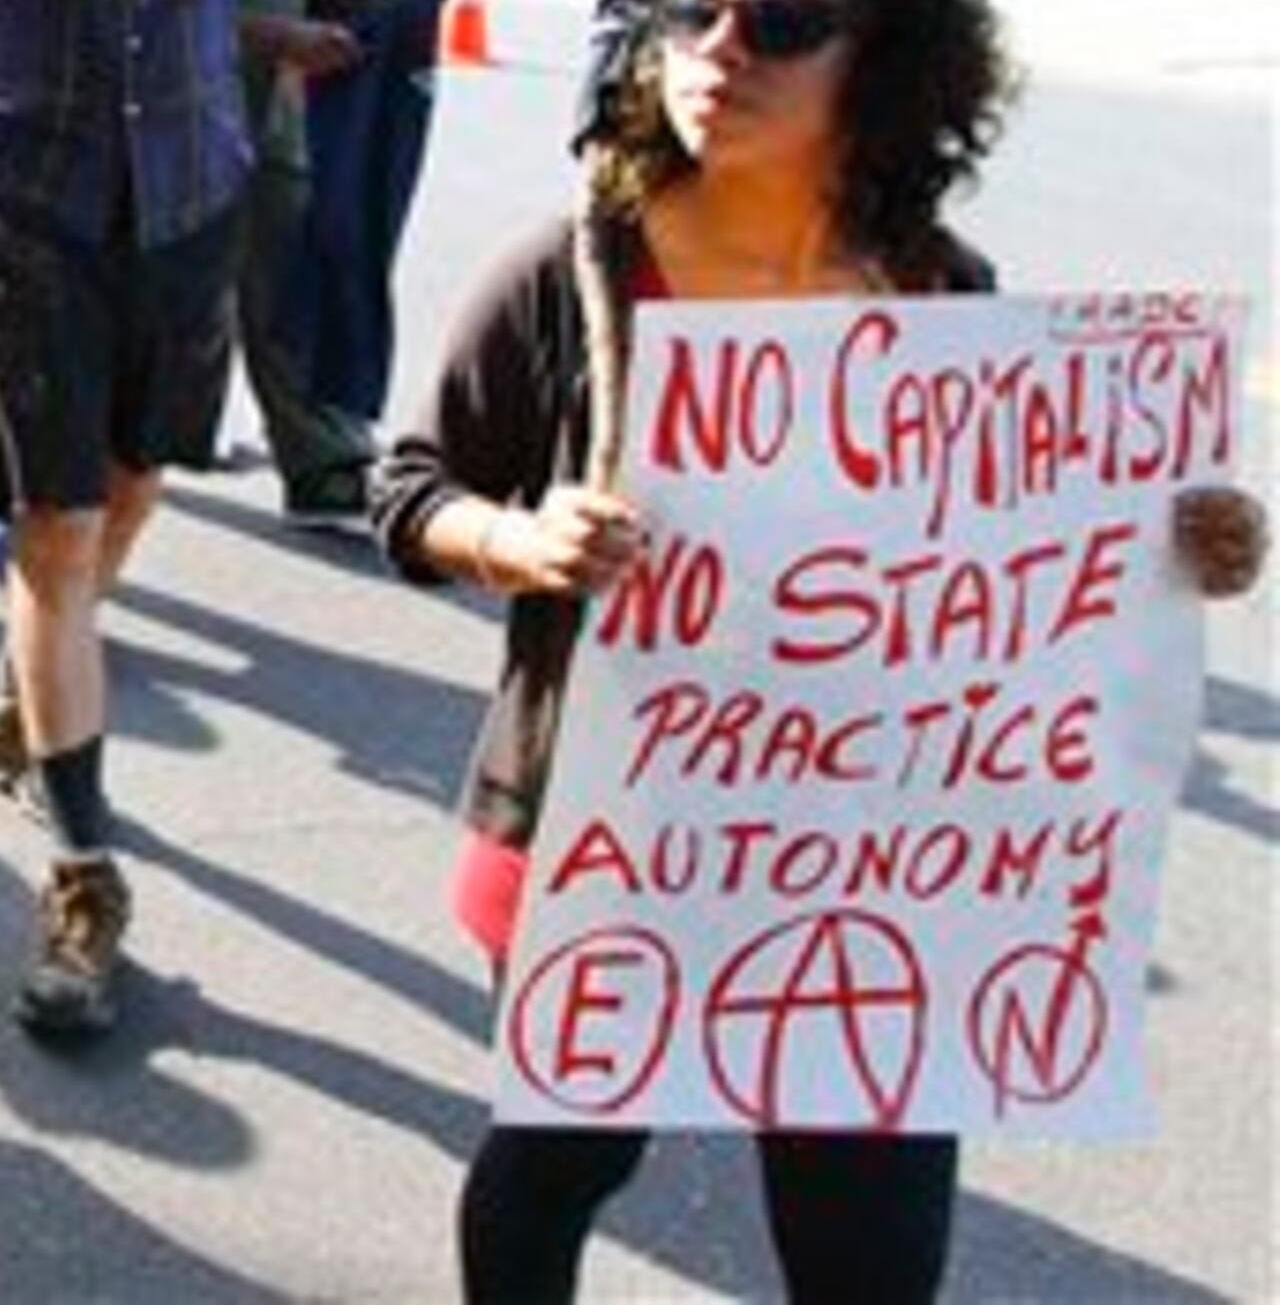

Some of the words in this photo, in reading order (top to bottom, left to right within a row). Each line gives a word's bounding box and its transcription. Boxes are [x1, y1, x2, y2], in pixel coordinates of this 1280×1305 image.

[651, 336, 794, 472] NO
[597, 529, 727, 652] NO
[771, 523, 1137, 665] STATE
[549, 810, 1123, 905] AUTONOMY
